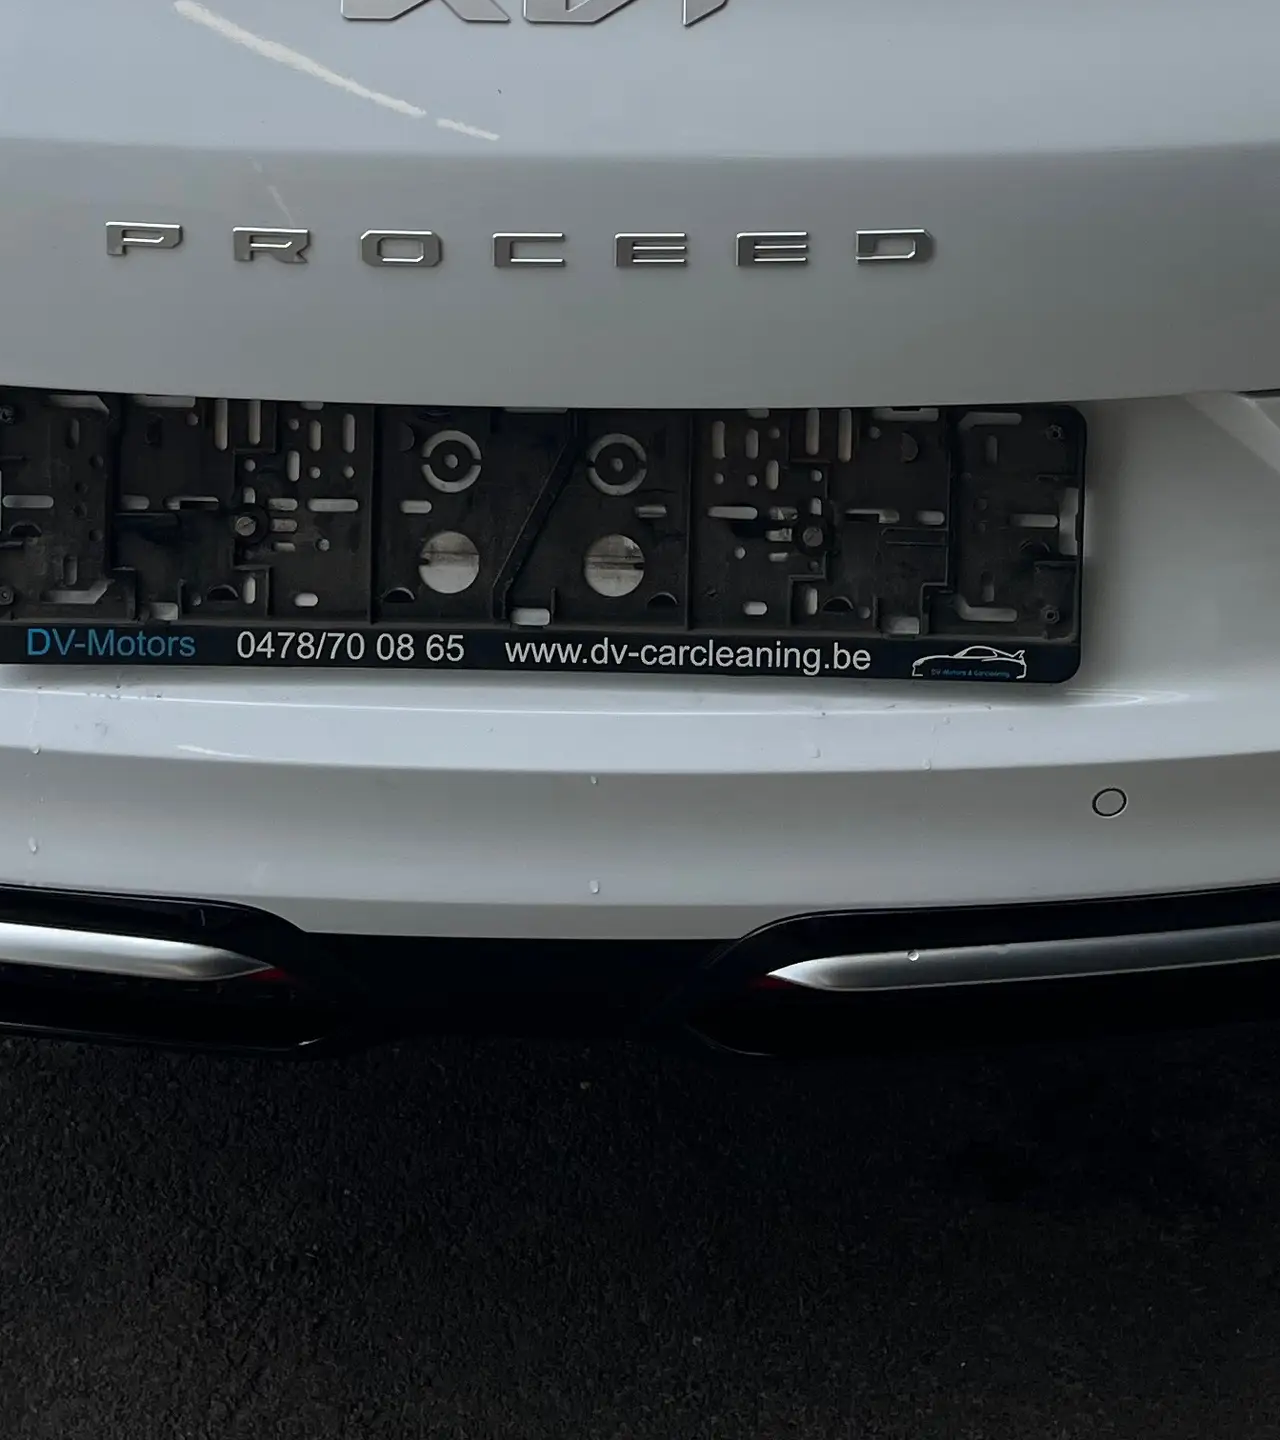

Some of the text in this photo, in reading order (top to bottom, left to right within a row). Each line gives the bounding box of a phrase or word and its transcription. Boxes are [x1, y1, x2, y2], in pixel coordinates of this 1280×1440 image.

[105, 220, 934, 268] PROCEED
[27, 628, 871, 676] DV-Motors 0478/70 08 65 www.dv-carcleaning.be
